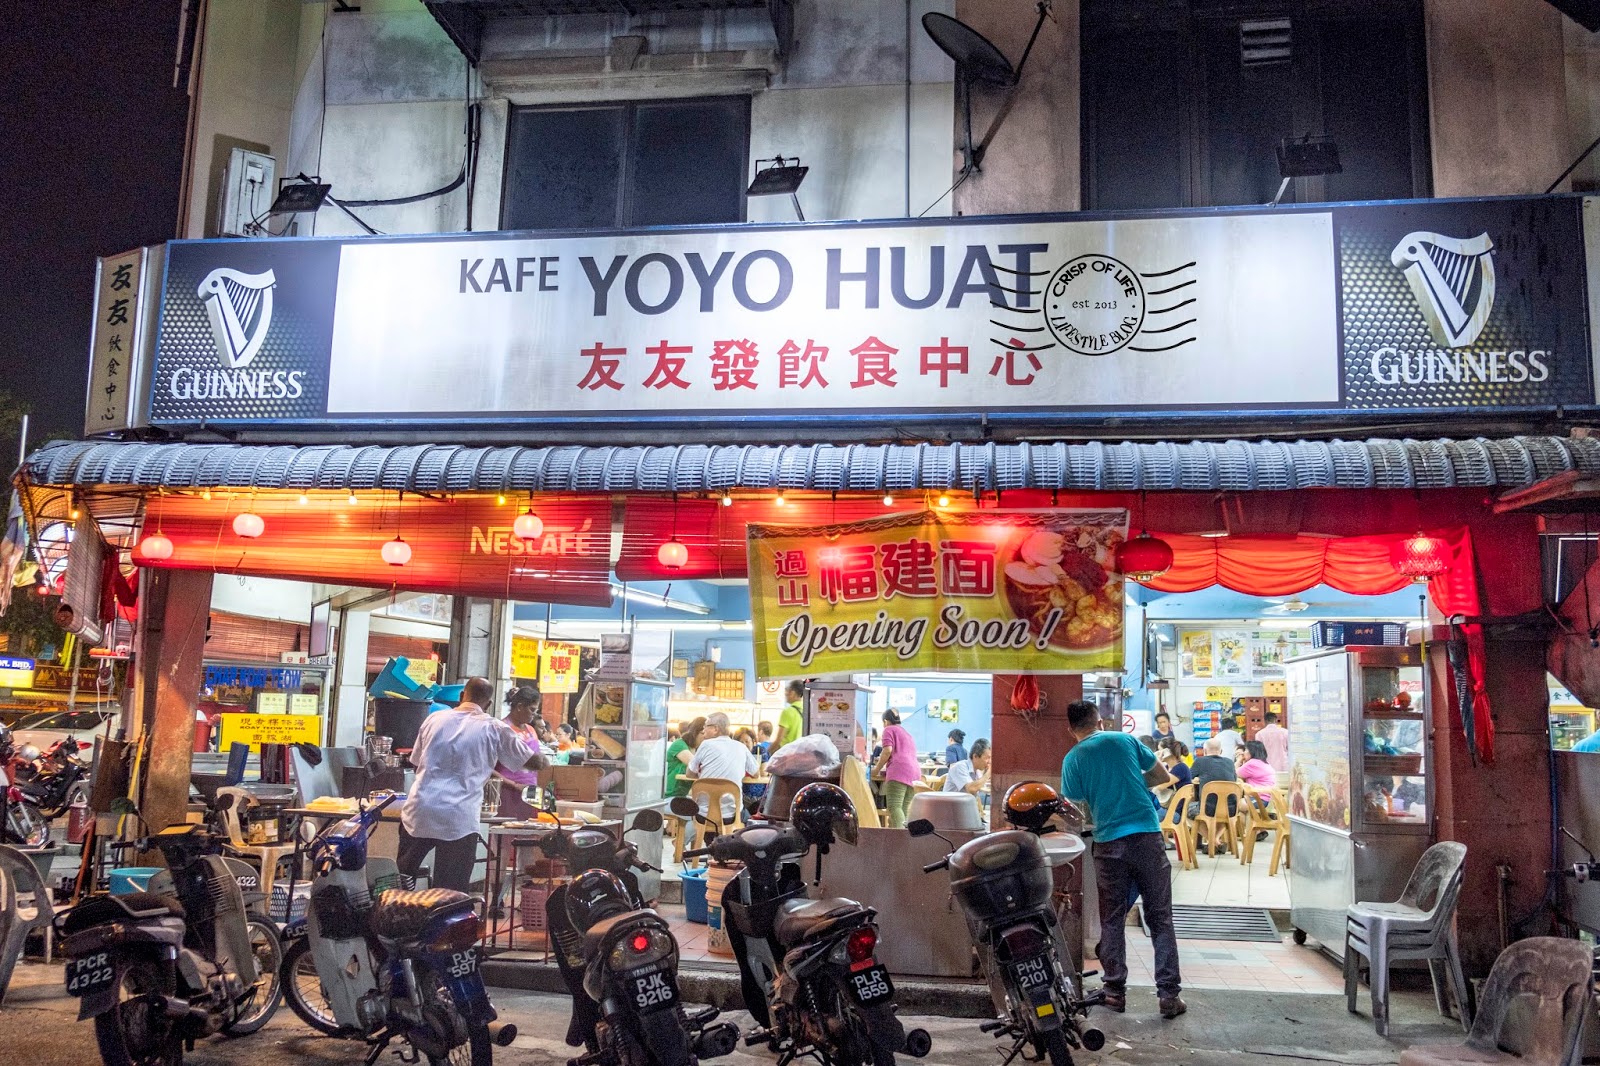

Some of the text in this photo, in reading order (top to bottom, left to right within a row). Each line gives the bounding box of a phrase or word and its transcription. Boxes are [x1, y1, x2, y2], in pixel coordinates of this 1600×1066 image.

[459, 243, 1048, 316] KAFE YOYO HUAT
[577, 336, 1043, 391] 友友發飲食中心
[775, 550, 809, 606] 過山
[780, 611, 927, 664] Opening
[934, 605, 1030, 647] Soon
[236, 876, 257, 887] 4322
[77, 953, 108, 972] PCR
[452, 949, 477, 965] PJC
[1016, 957, 1044, 976] PHU
[69, 967, 113, 990] 4322
[451, 960, 476, 978] 597
[636, 973, 666, 994] PJK
[854, 970, 882, 988] PLR
[1020, 970, 1049, 988] 2101
[637, 986, 673, 1008] 9216
[857, 982, 889, 1000] 1559
